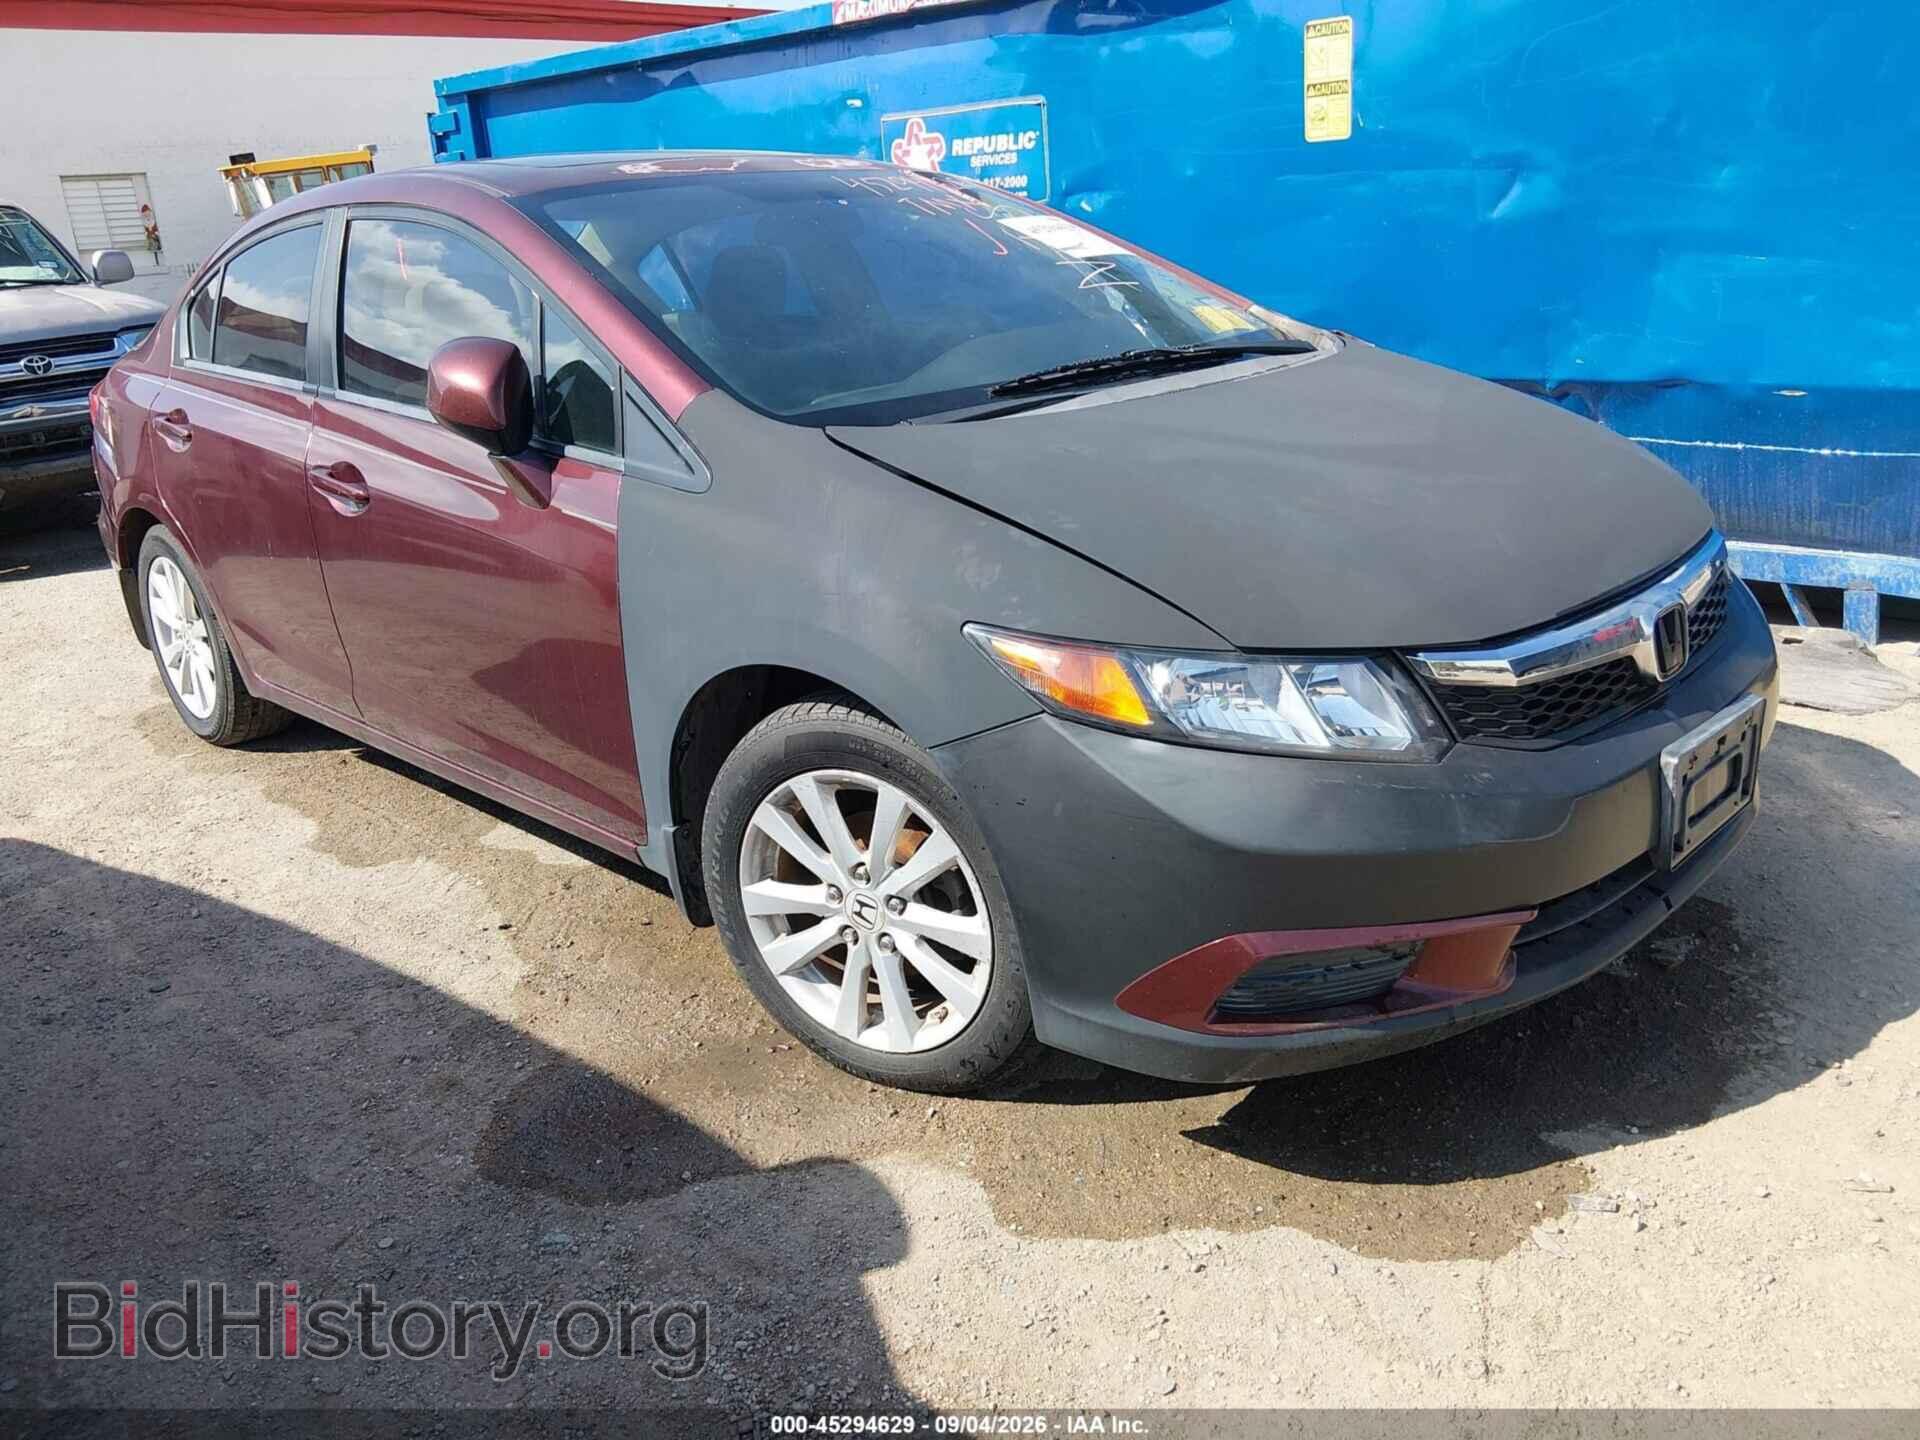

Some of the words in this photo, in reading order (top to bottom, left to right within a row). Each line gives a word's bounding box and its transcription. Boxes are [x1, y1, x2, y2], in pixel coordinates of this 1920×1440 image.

[1316, 20, 1349, 34] CAUTION
[1316, 80, 1349, 94] CAUTION
[952, 130, 1037, 157] REPUBLIC
[970, 151, 1018, 168] SERVICES
